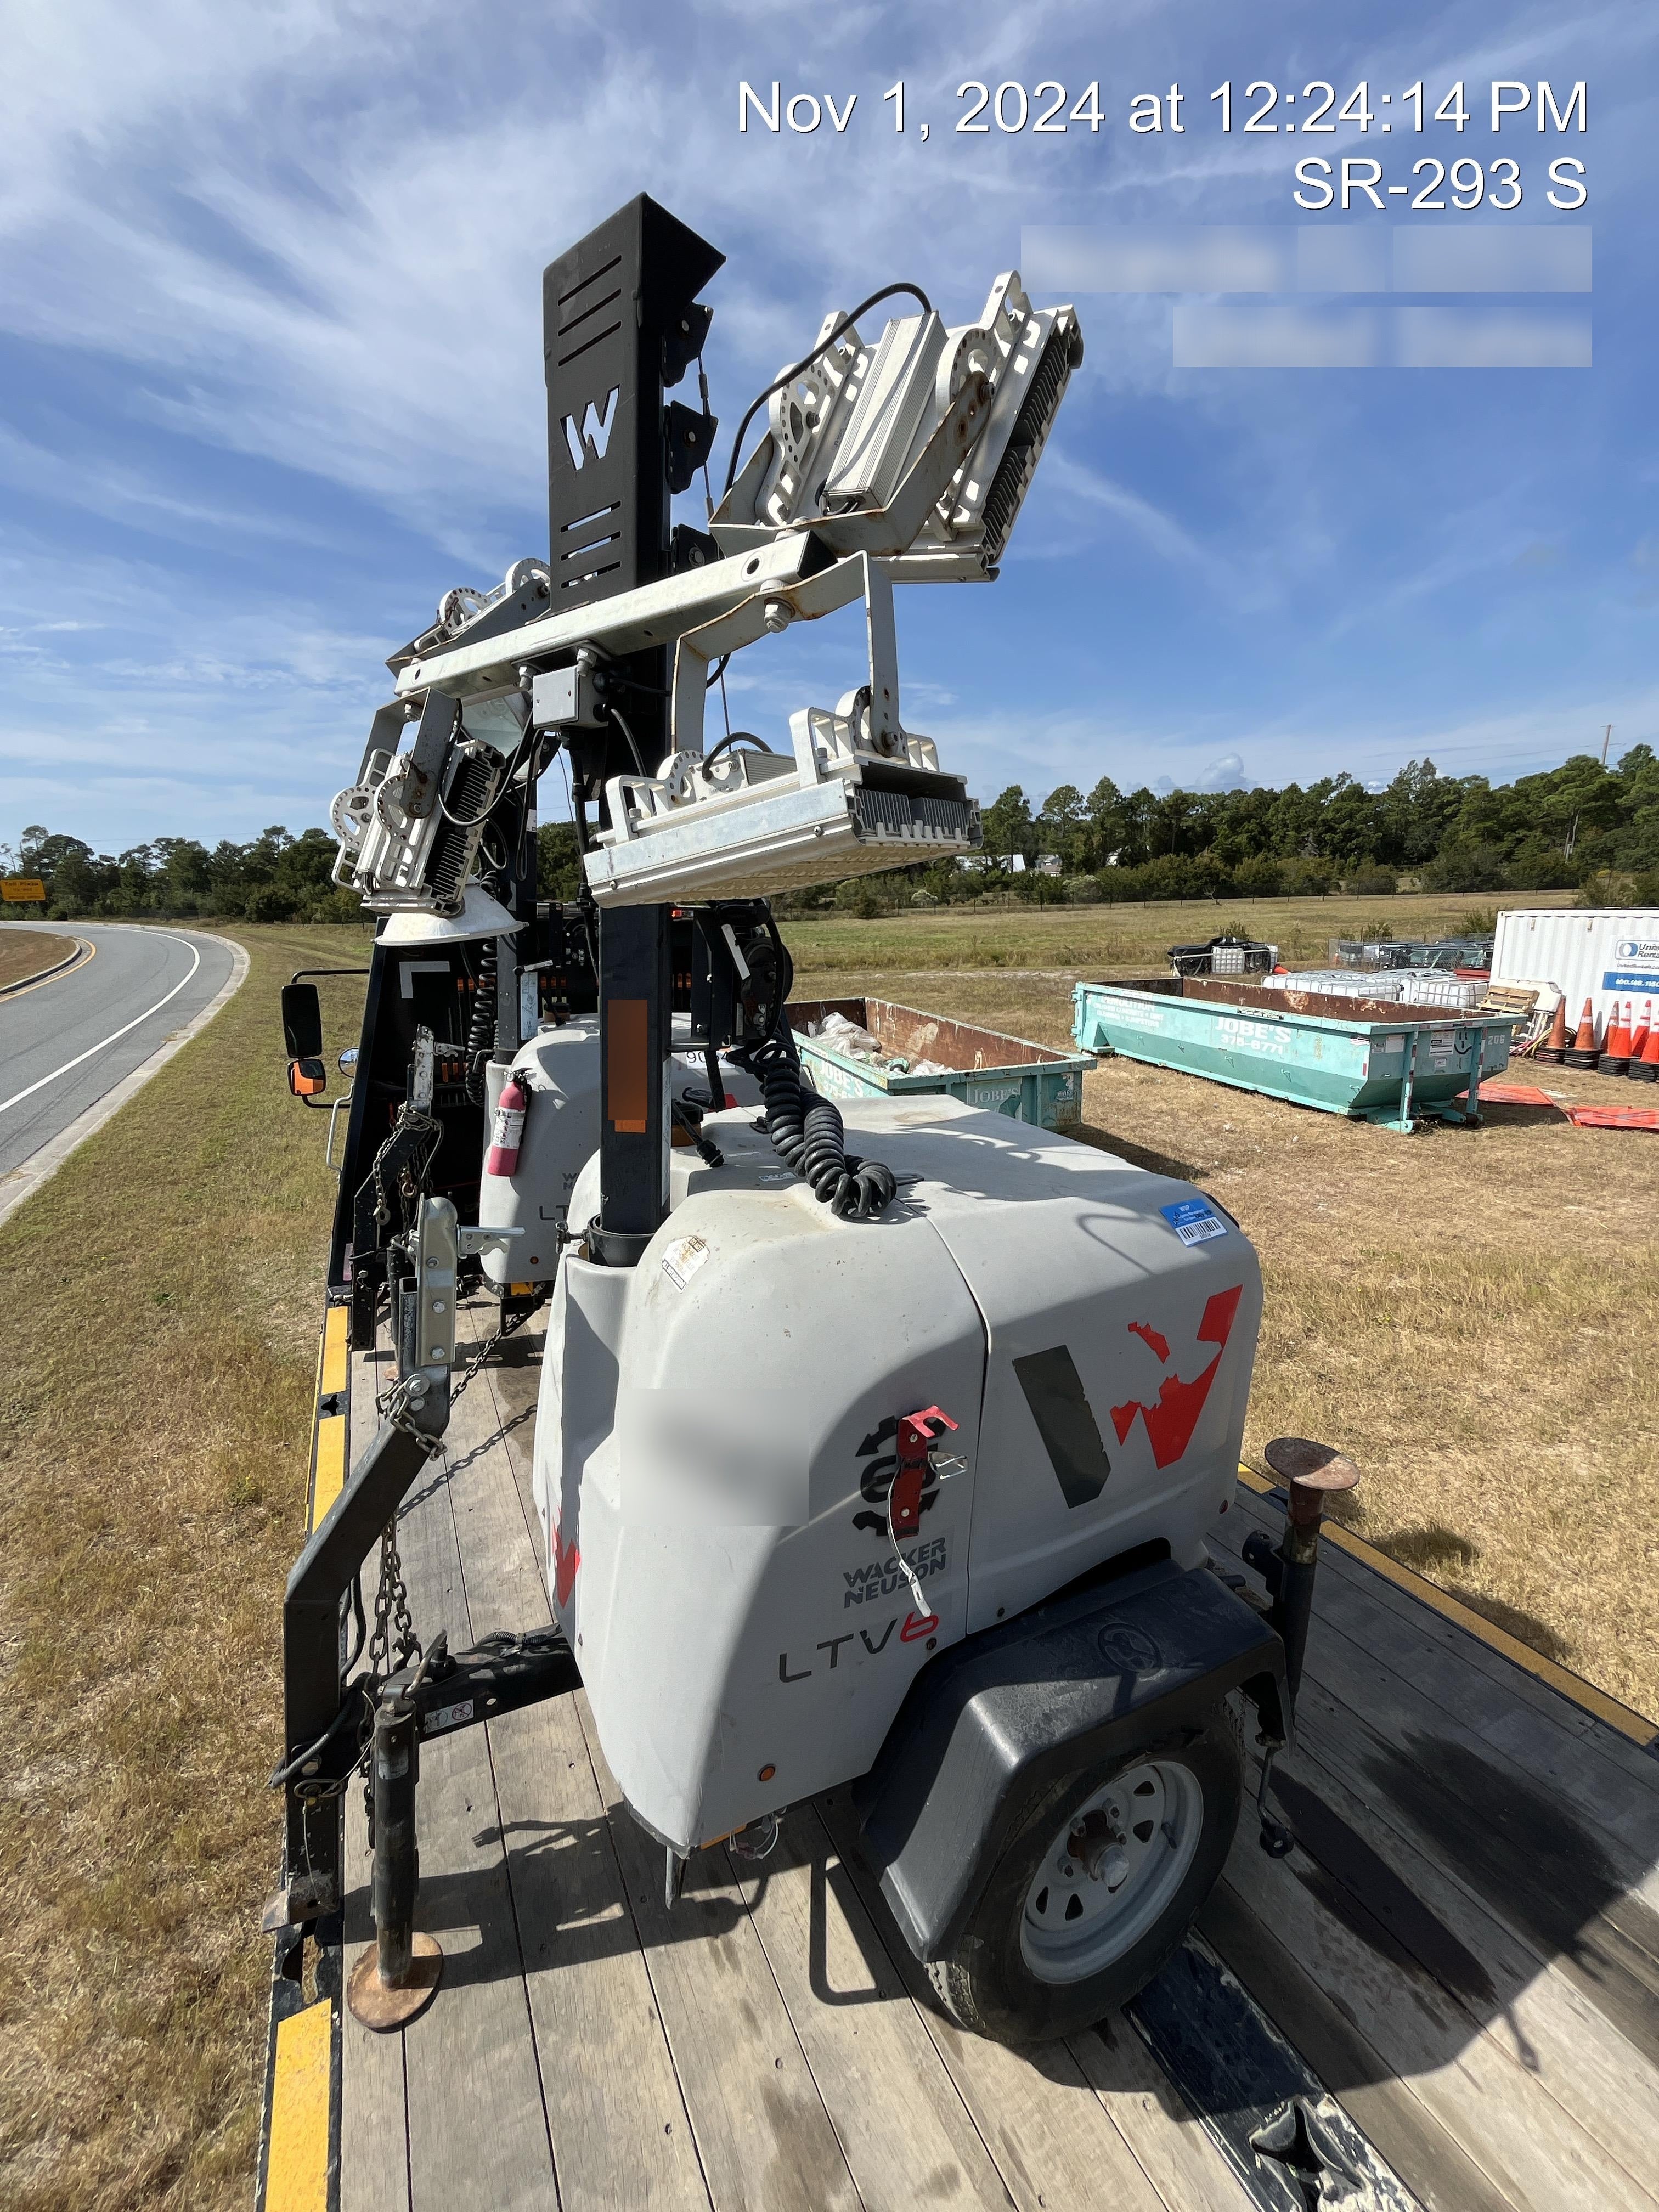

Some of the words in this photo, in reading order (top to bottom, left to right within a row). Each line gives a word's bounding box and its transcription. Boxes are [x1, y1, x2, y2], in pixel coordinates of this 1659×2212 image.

[1215, 1016, 1292, 1043] JOBE'S
[843, 1537, 947, 1588] WACKER
[844, 1554, 947, 1609] NEUSON
[778, 1611, 940, 1683] LTV6
